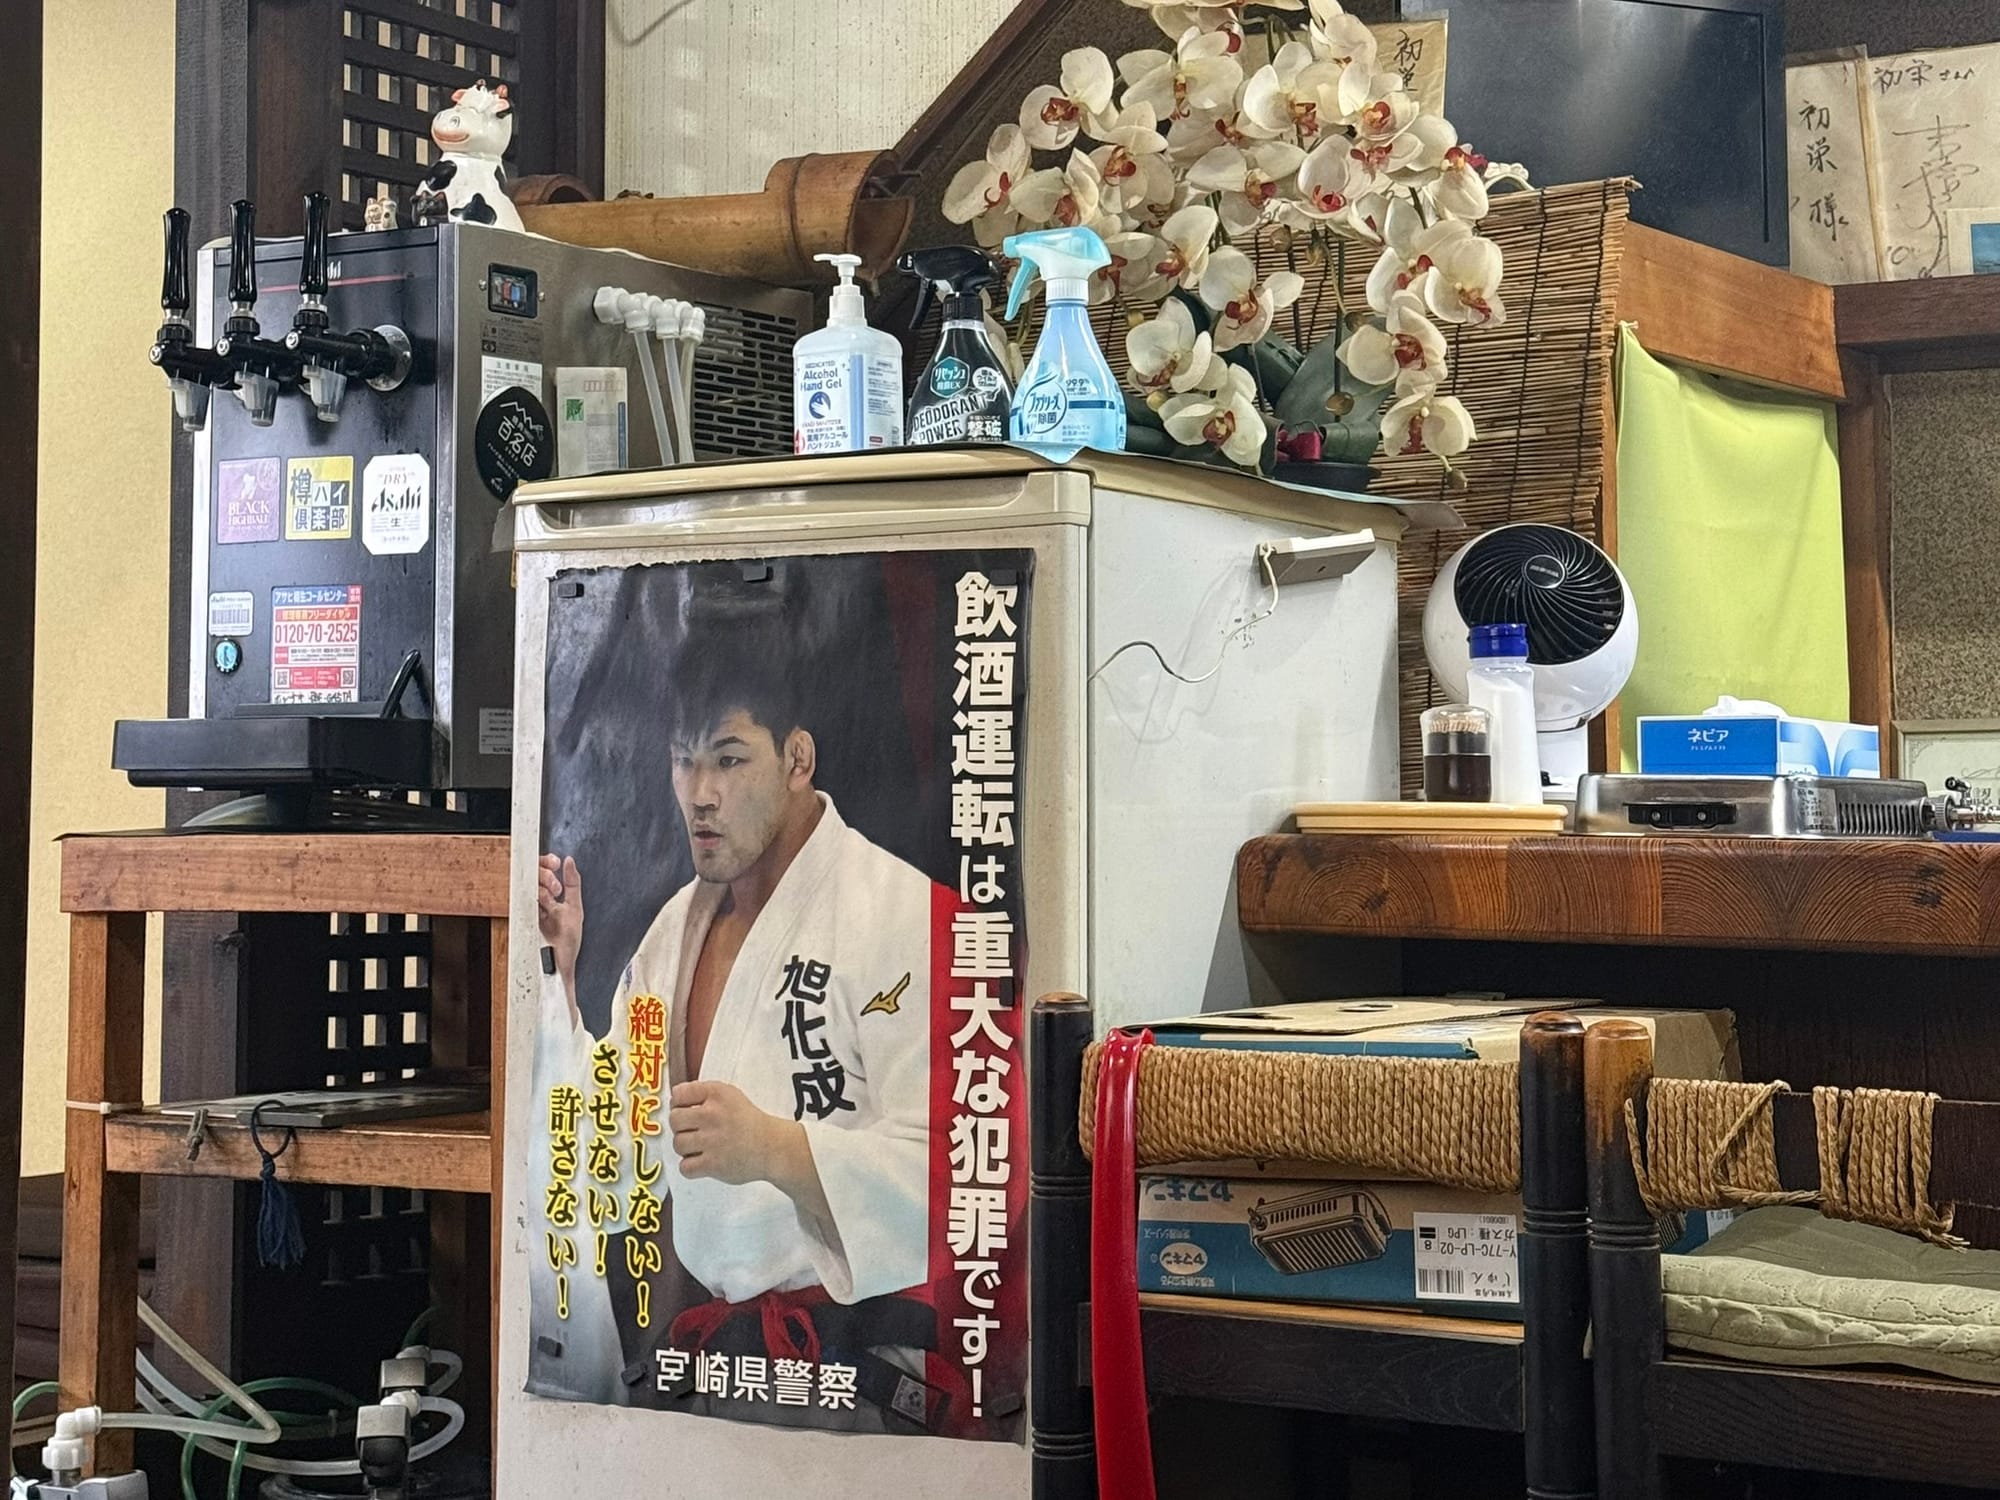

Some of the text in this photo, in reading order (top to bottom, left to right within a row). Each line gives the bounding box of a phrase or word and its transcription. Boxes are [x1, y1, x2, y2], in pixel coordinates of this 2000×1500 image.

[803, 367, 838, 380] Alcohol
[934, 366, 966, 382] リセッシュ
[800, 378, 842, 391] Hand Gel
[1028, 392, 1061, 413] ファブリーズ
[918, 419, 963, 443] POWER
[968, 420, 1002, 437] 撃破
[498, 416, 538, 467] 百名店
[228, 501, 270, 515] BLACK
[371, 486, 422, 513] Asahi
[295, 506, 346, 530] 倶楽部
[391, 517, 401, 527] 生
[275, 623, 357, 643] 0120-70-2525
[1688, 728, 1729, 743] ネピア
[947, 570, 1018, 1418] 飲酒運転は重大な犯罪です！
[775, 955, 857, 1120] 旭化成
[587, 1043, 620, 1276] させない！
[626, 996, 667, 1327] 絶対にしない！
[545, 1086, 583, 1319] 許さない！
[1161, 1251, 1206, 1265] ヤマキン
[1424, 1240, 1517, 1258] Y-77C-LP-02 8
[1471, 1272, 1511, 1288] じゅん
[655, 1347, 858, 1411] 宮崎県警察
